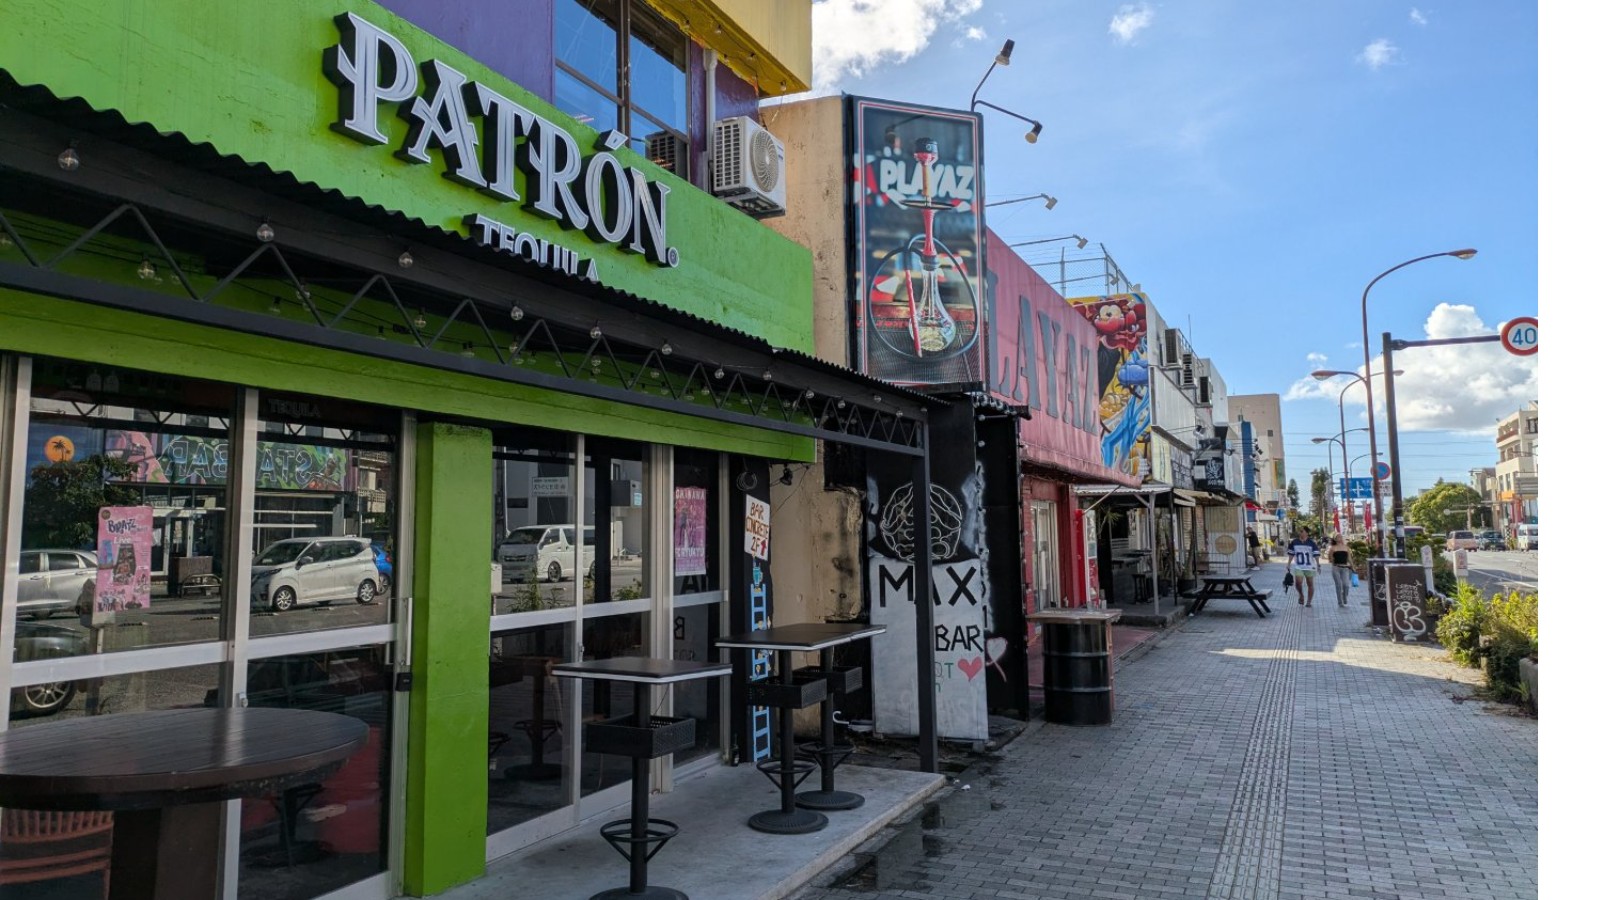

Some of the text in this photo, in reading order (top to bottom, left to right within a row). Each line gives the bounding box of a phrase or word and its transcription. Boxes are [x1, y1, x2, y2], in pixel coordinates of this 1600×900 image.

[880, 158, 974, 200] PLAYAZ
[1512, 327, 1537, 346] 40
[751, 502, 764, 520] BAR
[751, 536, 761, 553] 2F
[1296, 551, 1311, 565] 01
[935, 624, 984, 653] BAR
